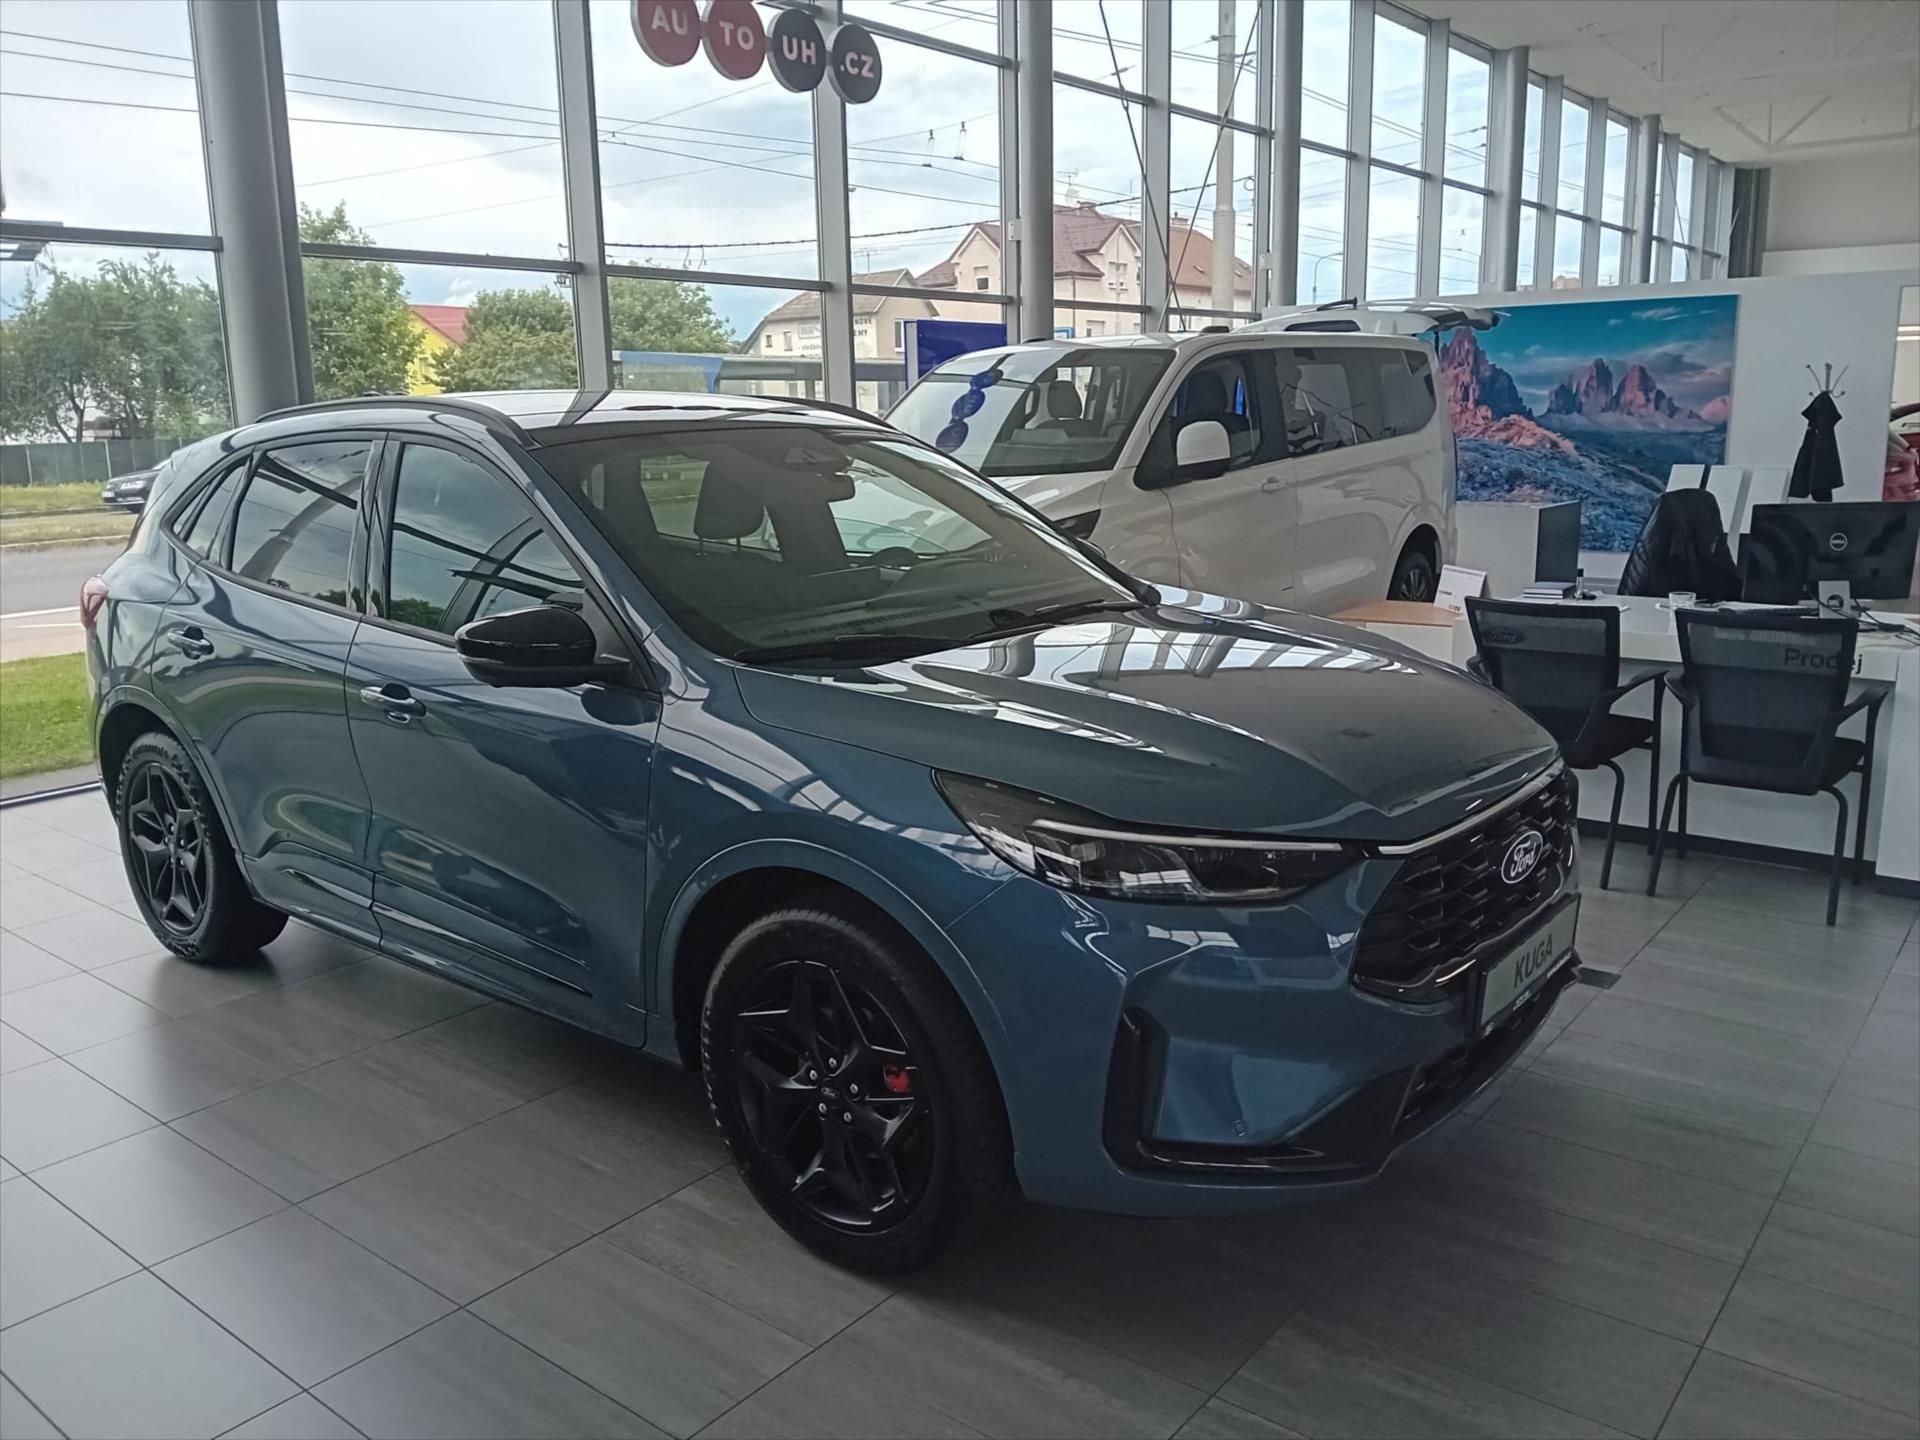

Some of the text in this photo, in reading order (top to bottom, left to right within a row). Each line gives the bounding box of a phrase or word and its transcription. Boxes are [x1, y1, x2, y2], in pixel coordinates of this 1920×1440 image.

[651, 5, 874, 78] AU TO UH .CZ
[1784, 648, 1863, 675] Prodj
[1510, 840, 1537, 877] Ford
[1513, 934, 1553, 988] KUGA
